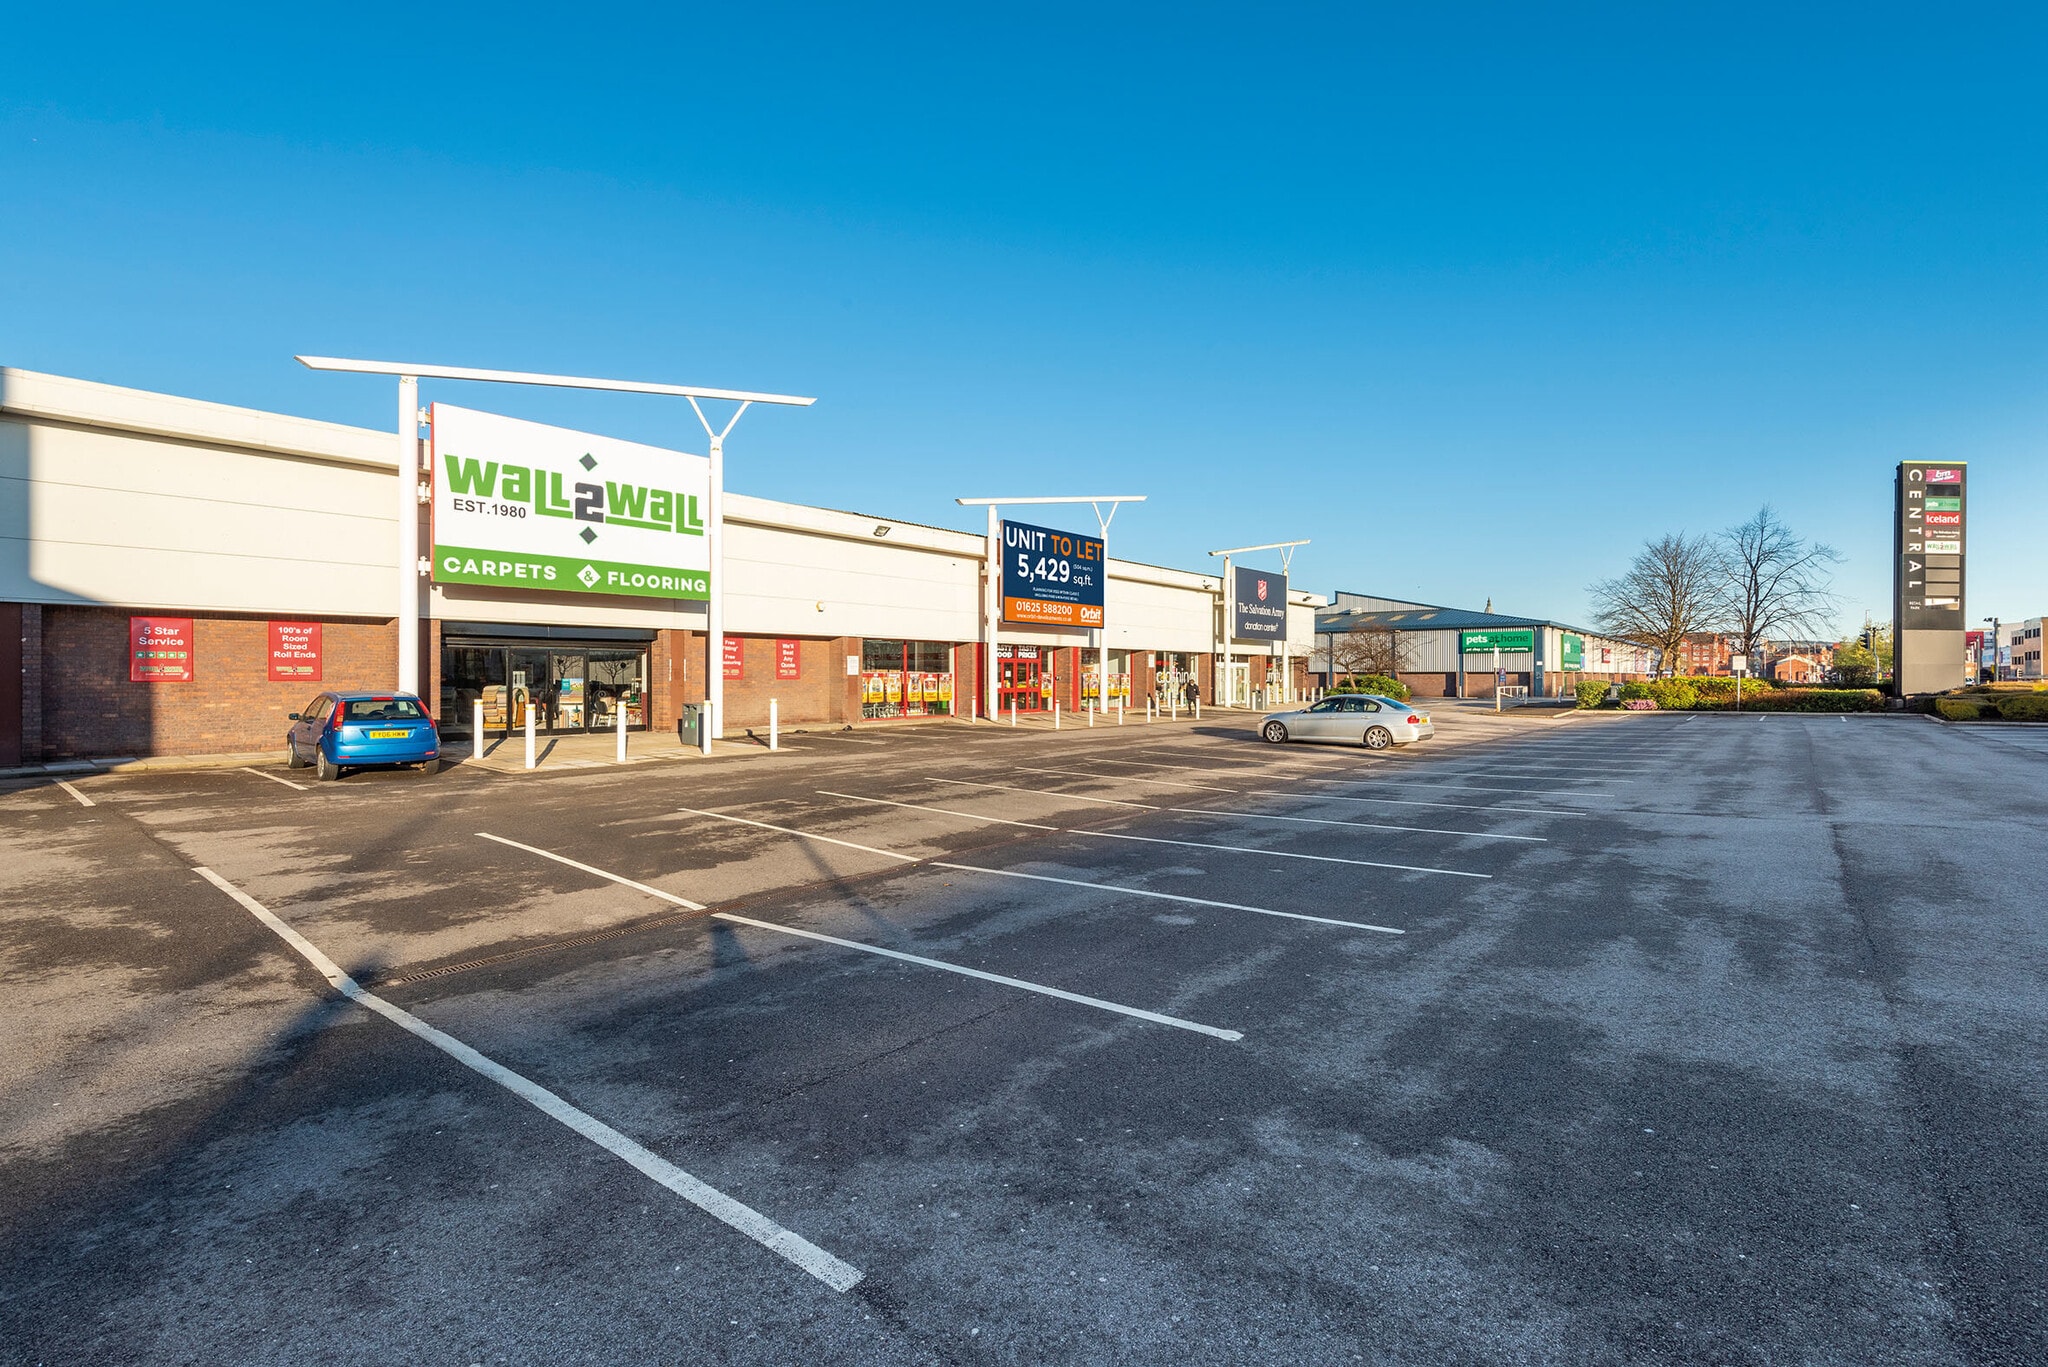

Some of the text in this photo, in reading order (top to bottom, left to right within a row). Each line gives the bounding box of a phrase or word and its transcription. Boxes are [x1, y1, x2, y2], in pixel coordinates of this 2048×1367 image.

[454, 498, 526, 519] EST.1980
[1926, 515, 1959, 523] Iceland
[1908, 469, 1922, 588] CENTRAL
[1006, 526, 1102, 561] UNIT TO LET
[443, 557, 706, 593] CARPETS & FLOORING
[1017, 553, 1070, 583] 5,429
[1016, 601, 1072, 615] 01625 588200
[1080, 607, 1101, 619] Orbit
[1238, 602, 1284, 620] The Salvation Army
[144, 626, 180, 635] 5 Star
[278, 626, 300, 634] 100's
[138, 636, 184, 646] Service
[1466, 634, 1488, 645] pets
[1501, 634, 1528, 642] home
